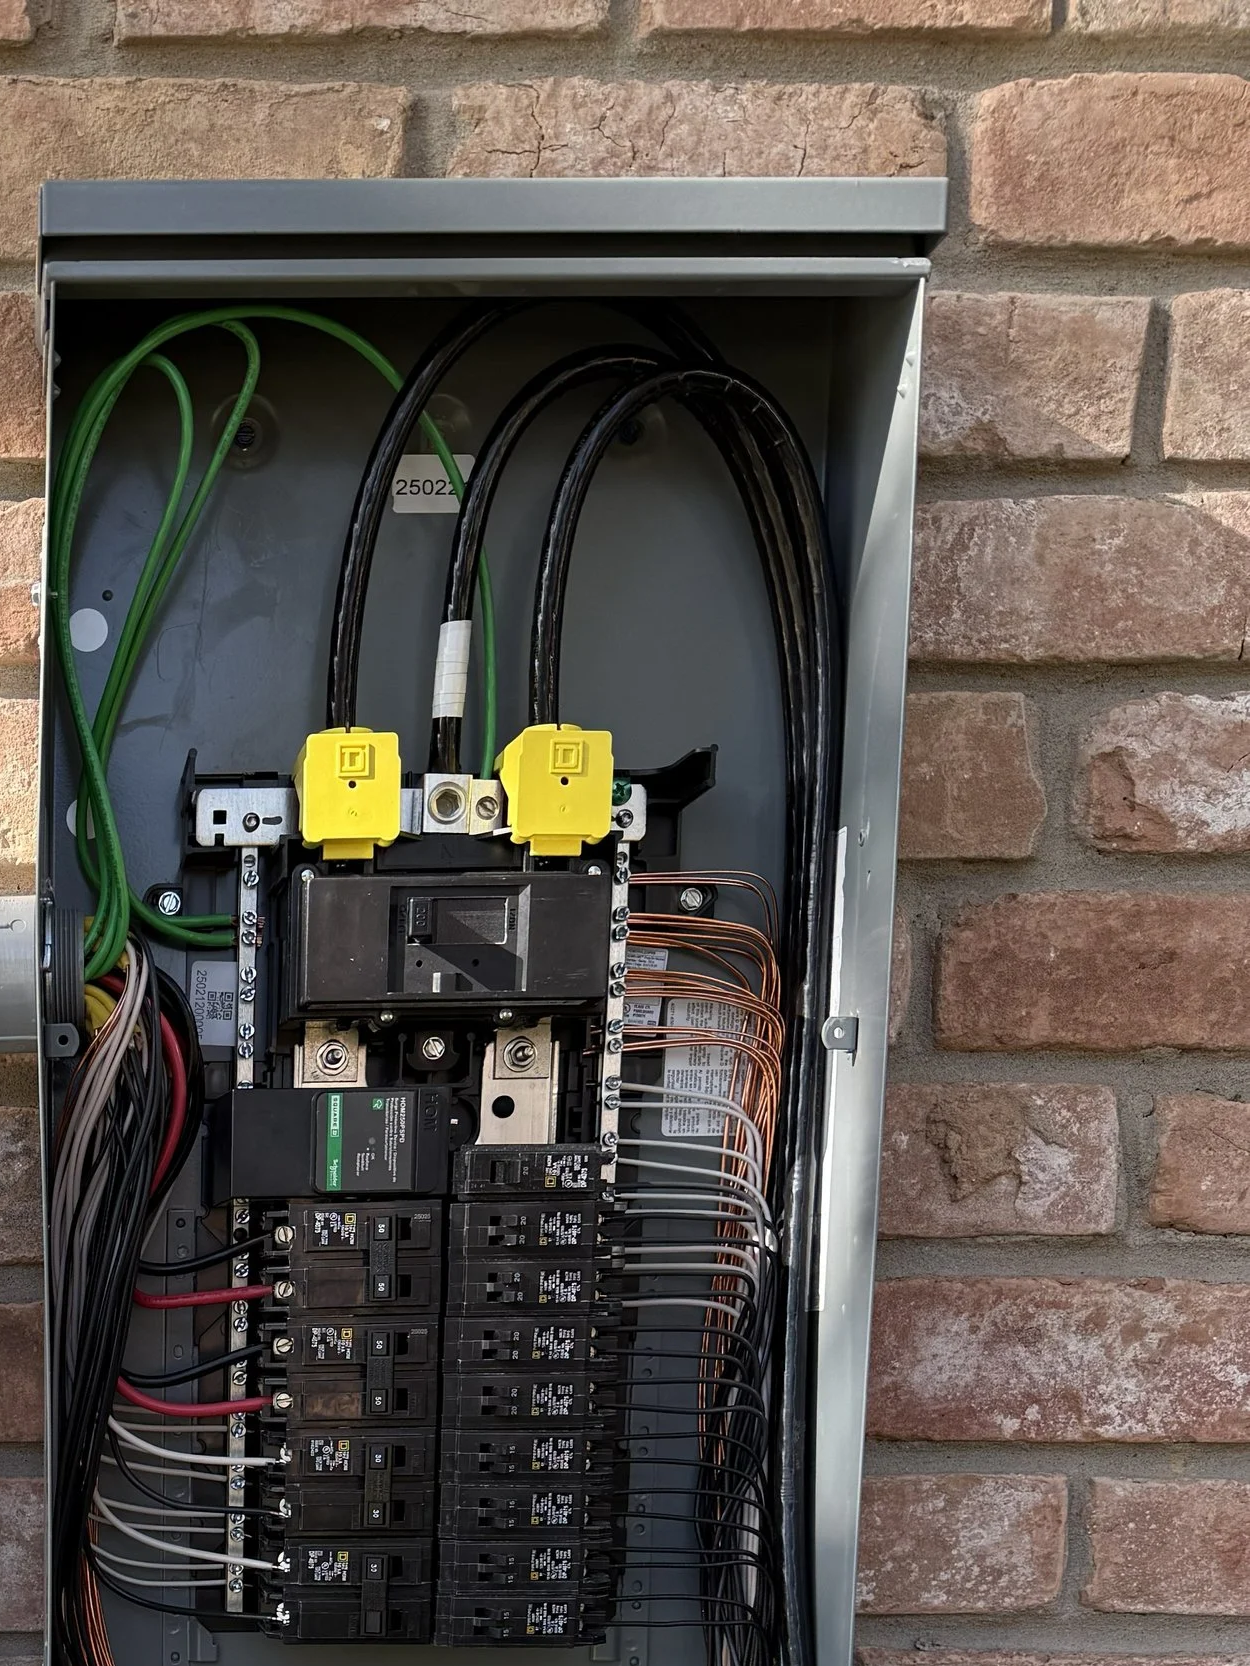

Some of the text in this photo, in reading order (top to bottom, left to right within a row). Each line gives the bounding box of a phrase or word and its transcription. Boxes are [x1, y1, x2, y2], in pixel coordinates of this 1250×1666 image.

[523, 1166, 529, 1175] 20
[520, 1216, 527, 1226] 20
[378, 1224, 385, 1233] 50
[519, 1234, 525, 1244] 20
[514, 1272, 520, 1282] 20
[378, 1282, 385, 1292] 50
[517, 1291, 523, 1301] 20
[514, 1331, 519, 1341] 20
[376, 1340, 383, 1349] 50
[512, 1350, 518, 1360] 20
[511, 1388, 518, 1398] 20
[375, 1396, 382, 1405] 50
[511, 1406, 518, 1415] 20
[510, 1446, 516, 1454] 15
[375, 1454, 381, 1463] 30
[509, 1464, 515, 1472] 15
[373, 1509, 379, 1518] 30
